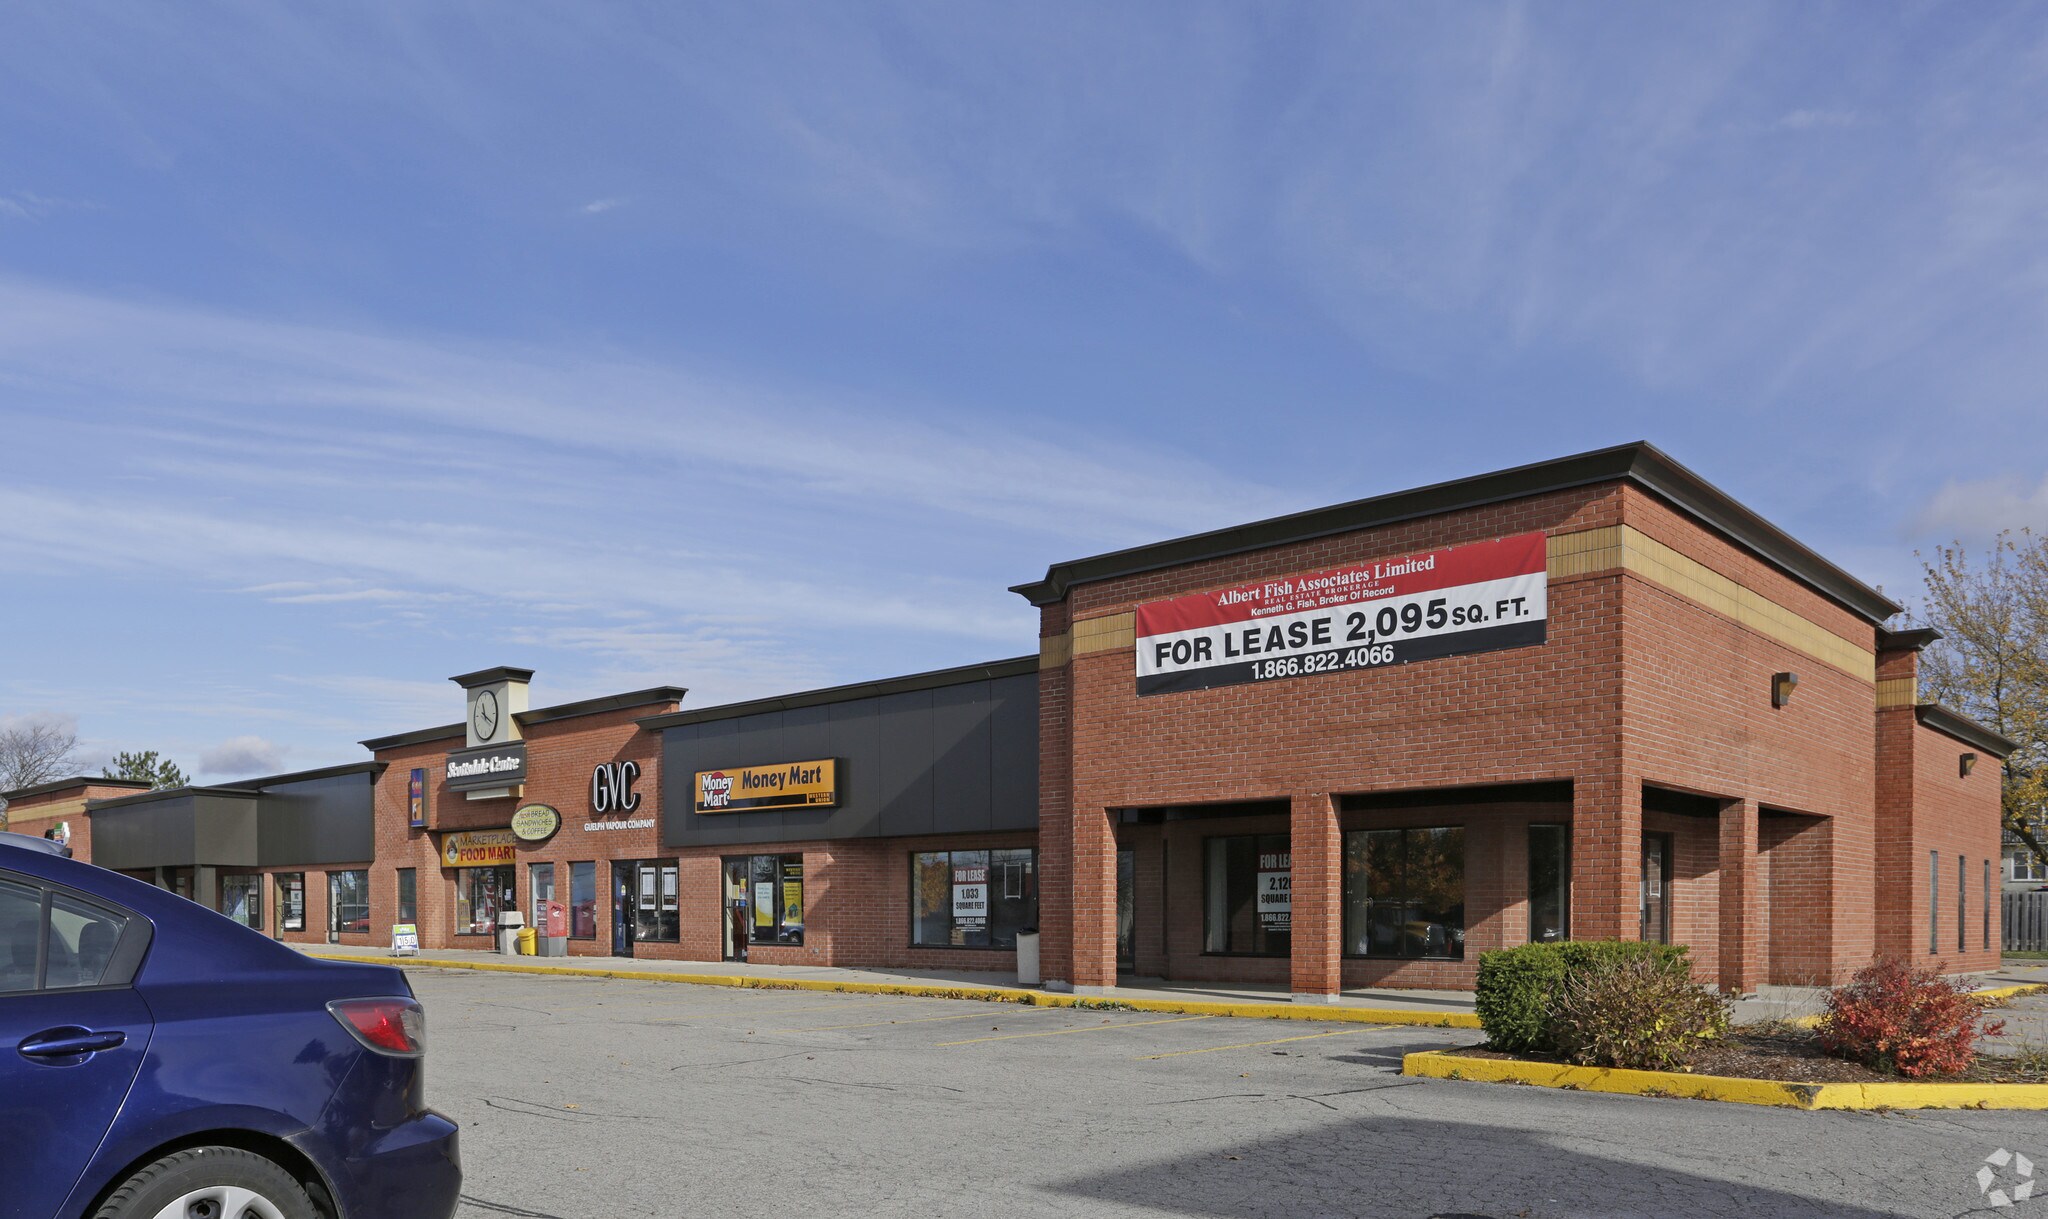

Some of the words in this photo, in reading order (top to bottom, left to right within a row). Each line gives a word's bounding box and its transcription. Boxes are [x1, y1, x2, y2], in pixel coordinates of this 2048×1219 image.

[1217, 587, 1261, 606] Albert
[1263, 581, 1293, 599] Fish
[1296, 570, 1370, 593] Associates
[1374, 554, 1435, 580] Limited
[1251, 604, 1284, 616] Kenneth
[1285, 602, 1295, 611] G.
[1297, 599, 1317, 609] Fish,
[1319, 594, 1348, 606] Broker
[1350, 590, 1361, 600] Of
[1362, 585, 1395, 598] Record
[1264, 596, 1286, 605] REAL
[1290, 590, 1321, 600] ESTATE
[1325, 580, 1380, 595] BROKERAGE
[1155, 636, 1213, 668] FOR
[1224, 616, 1332, 658] LEASE
[1346, 597, 1448, 645] 2,095
[1452, 604, 1489, 626] SQ.
[1496, 596, 1529, 620] FT.
[1251, 644, 1394, 680] 1.866.822.4066
[489, 756, 520, 773] Centre
[701, 773, 734, 794] Money
[742, 770, 786, 791] Money
[789, 765, 822, 786] Mart
[592, 761, 641, 813] GVC
[703, 790, 731, 807] Mart
[531, 809, 550, 818] BREAD
[516, 817, 553, 828] SANDWICHES
[583, 822, 605, 832] GUELPH
[605, 820, 627, 830] VAPOUR
[627, 818, 656, 829] COMPANY
[526, 827, 548, 835] COFFEE
[460, 833, 517, 847] MARKETPLACE
[460, 847, 486, 862] FOOD
[487, 845, 516, 860] MART
[1260, 854, 1277, 869] FOR
[955, 870, 967, 882] FOR
[967, 869, 985, 882] LEASE
[961, 888, 979, 900] 1,033
[1261, 893, 1288, 904] SQUARE
[955, 901, 974, 910] SQUARE
[974, 901, 985, 910] FEET
[1260, 913, 1291, 922] 1.866.822.
